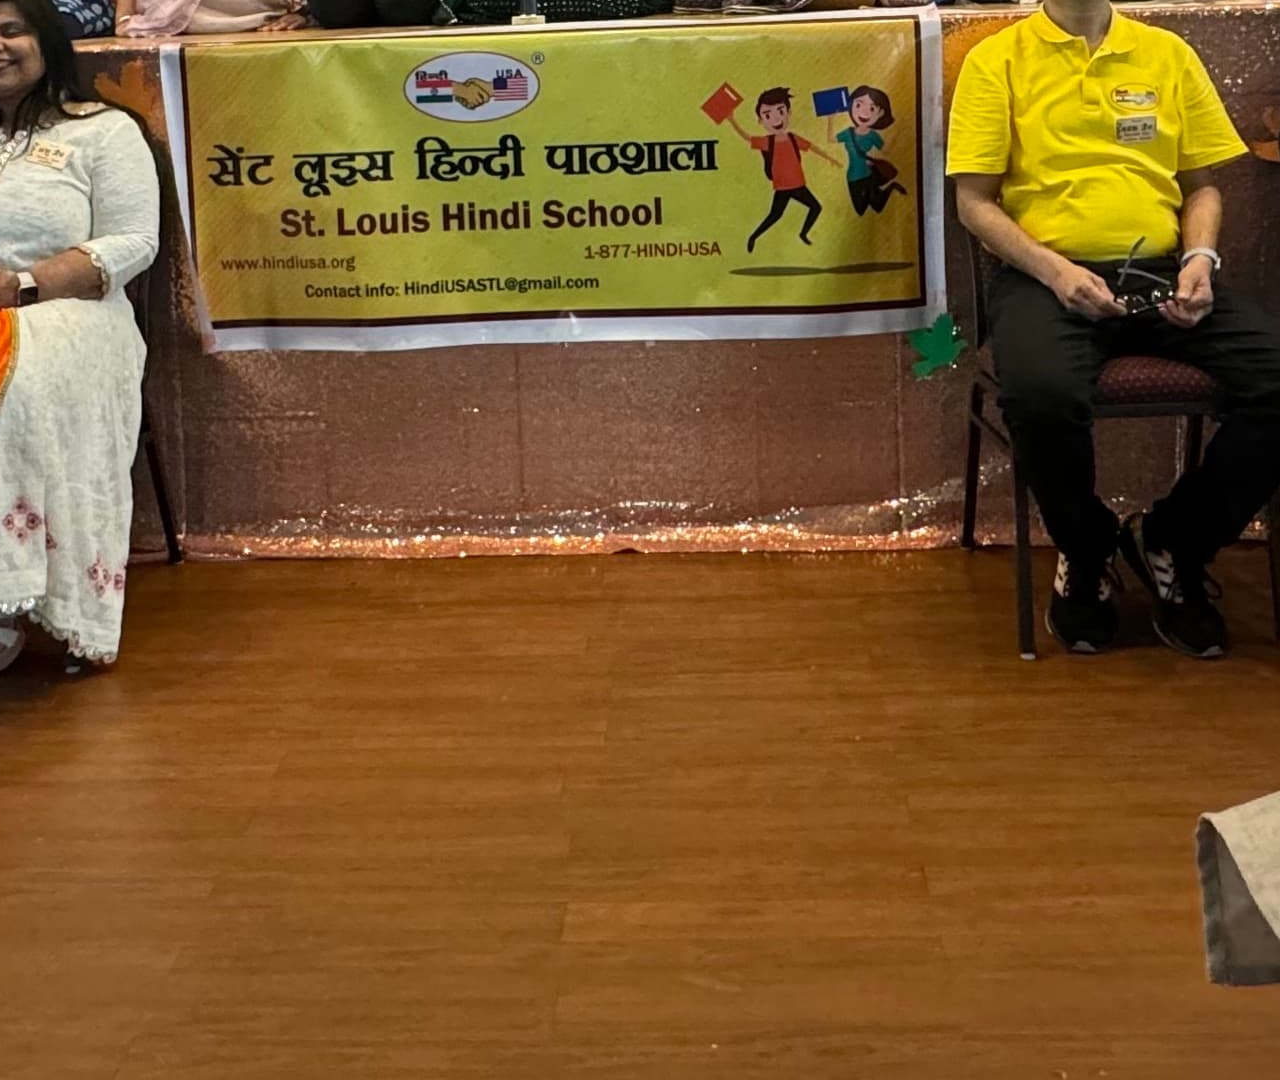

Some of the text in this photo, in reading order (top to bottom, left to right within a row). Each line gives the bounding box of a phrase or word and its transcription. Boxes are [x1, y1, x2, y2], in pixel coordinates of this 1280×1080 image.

[495, 68, 524, 80] USA
[206, 133, 719, 198] सेंट लूइस हिन्दी पाठशाला
[279, 196, 663, 238] St. Louis Hindi School
[583, 240, 722, 260] 1-877-HINDI-USA
[220, 255, 356, 273] www.hindiusa.org
[304, 275, 600, 299] Contact info: HindiUSASTL@gmail.com
